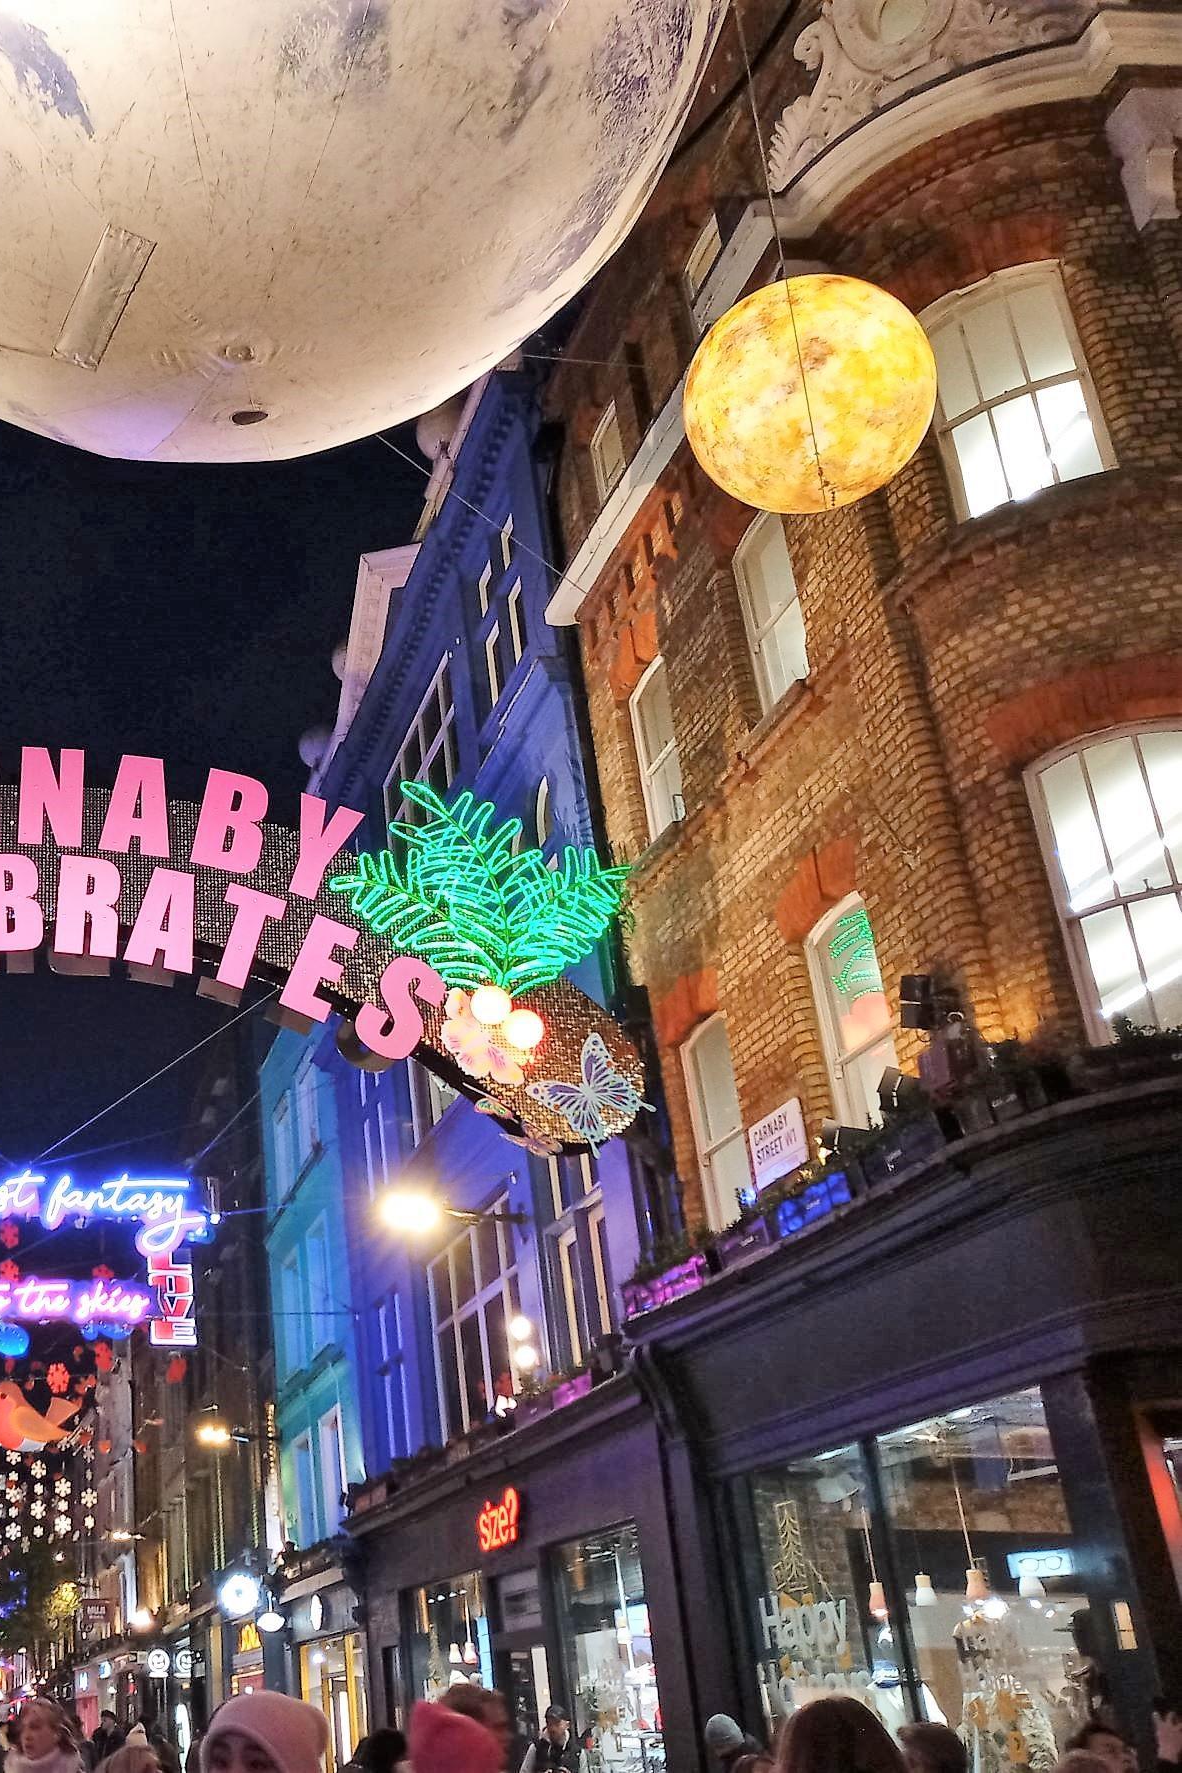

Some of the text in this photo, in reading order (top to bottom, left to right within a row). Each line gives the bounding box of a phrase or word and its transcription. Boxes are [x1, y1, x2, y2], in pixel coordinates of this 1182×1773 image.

[753, 1112, 788, 1146] CARNABY
[756, 1136, 784, 1166] STREET
[47, 1172, 207, 1253] fantasy
[13, 1281, 71, 1314] the
[74, 1280, 151, 1319] skies
[479, 1487, 519, 1552] size?
[758, 1593, 847, 1657] Happy
